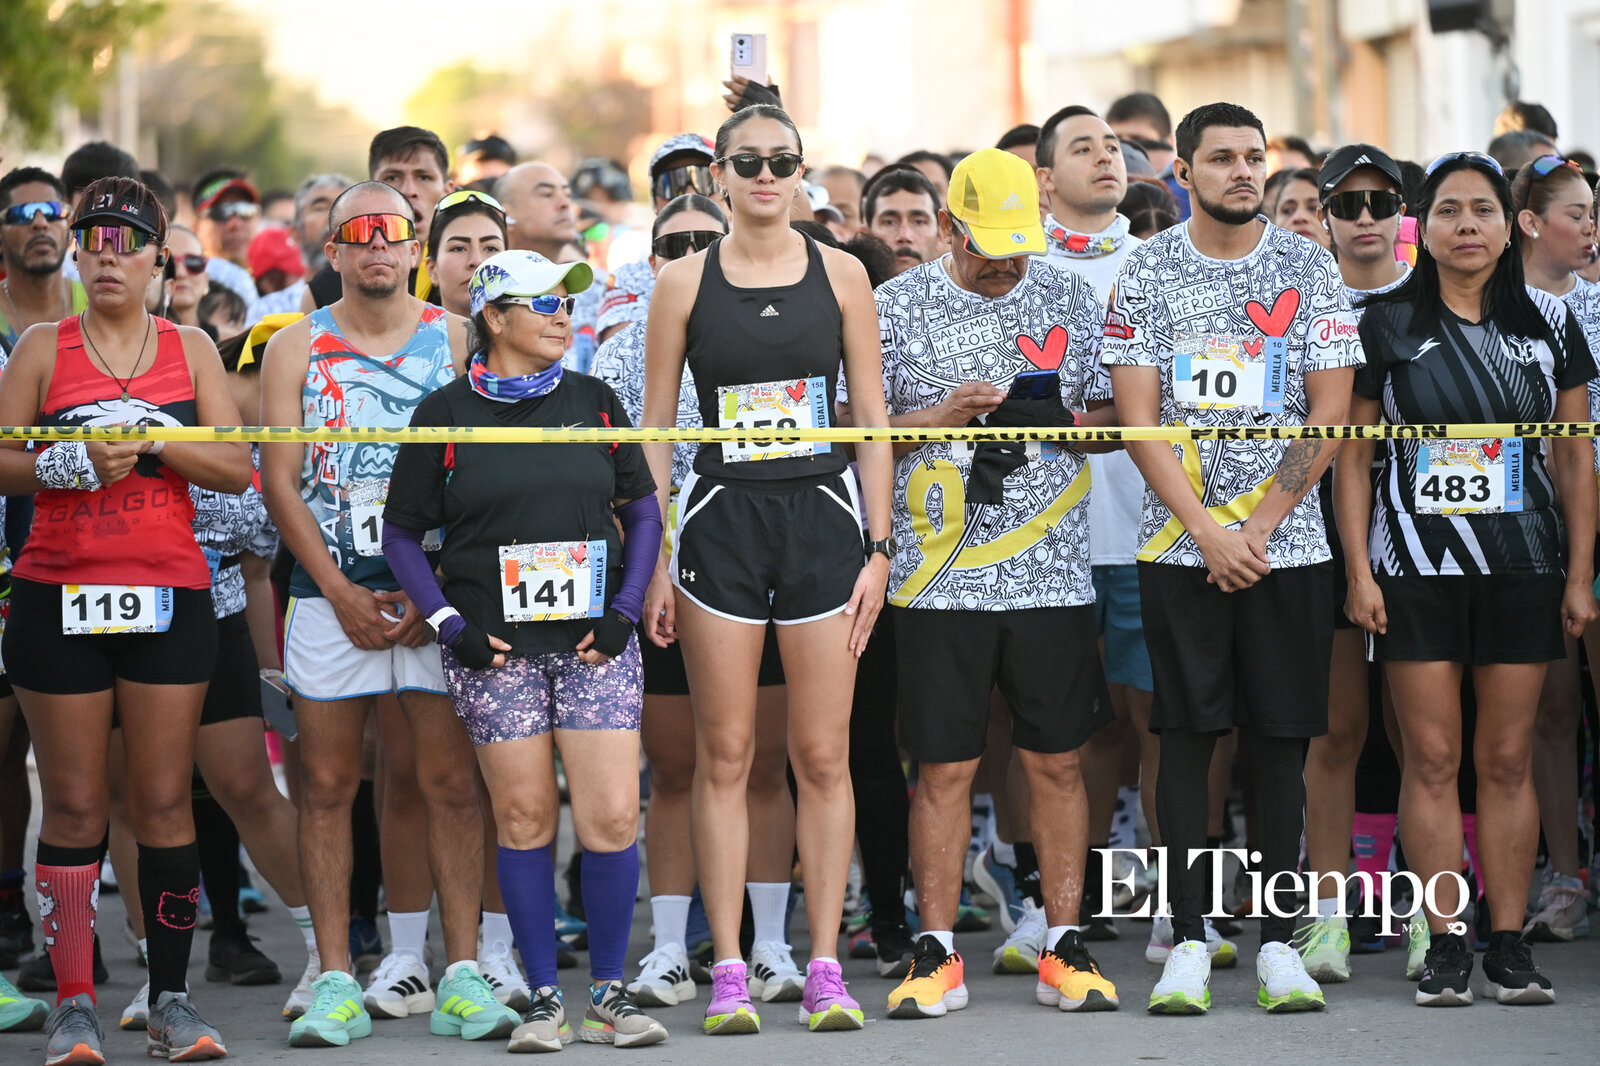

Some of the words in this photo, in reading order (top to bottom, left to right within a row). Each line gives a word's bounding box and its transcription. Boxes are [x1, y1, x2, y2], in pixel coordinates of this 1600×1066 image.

[1166, 281, 1228, 304] SALVEMOS
[931, 314, 998, 342] SALVEMOS
[1191, 369, 1237, 398] 10
[1271, 354, 1282, 393] MEDALLA
[815, 393, 827, 428] EDALLA
[864, 430, 1122, 441] CAUCION
[1191, 424, 1448, 440] PRECAUCION
[1511, 453, 1520, 492] MEDALLA
[1420, 474, 1491, 503] 483
[48, 486, 186, 523] GALGOS
[50, 517, 140, 535] RUNNING
[595, 557, 604, 597] MEDALLA
[70, 592, 142, 622] 119
[511, 579, 575, 609] 141
